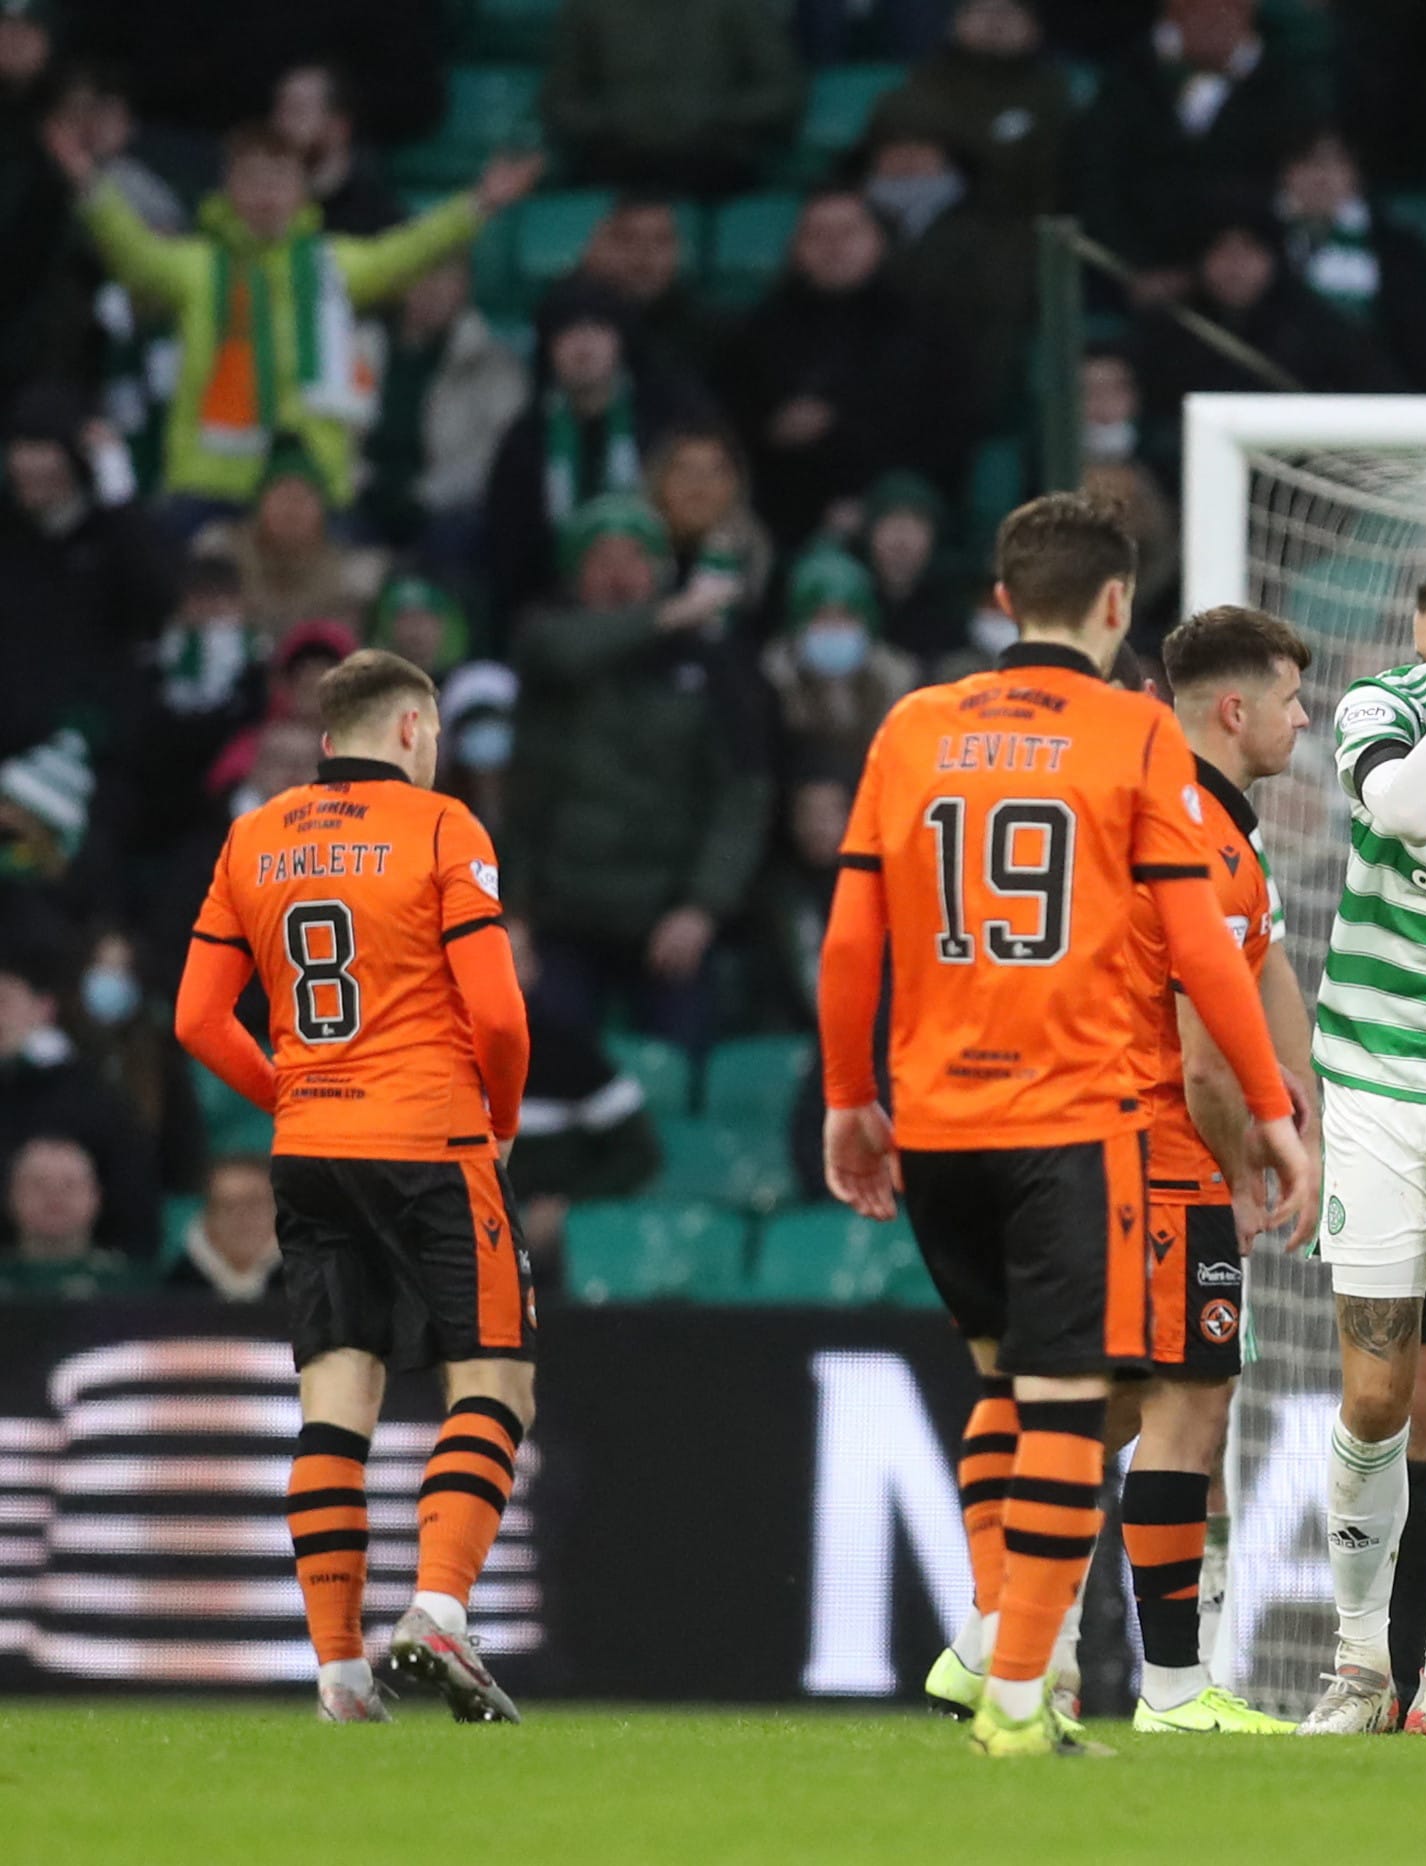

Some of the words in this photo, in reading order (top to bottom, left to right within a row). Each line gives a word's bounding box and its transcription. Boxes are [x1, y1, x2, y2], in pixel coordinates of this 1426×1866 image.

[936, 732, 1073, 774] LEVITT
[256, 843, 392, 887] PAWLETT
[924, 797, 1076, 967] 19
[283, 899, 361, 1045] 8
